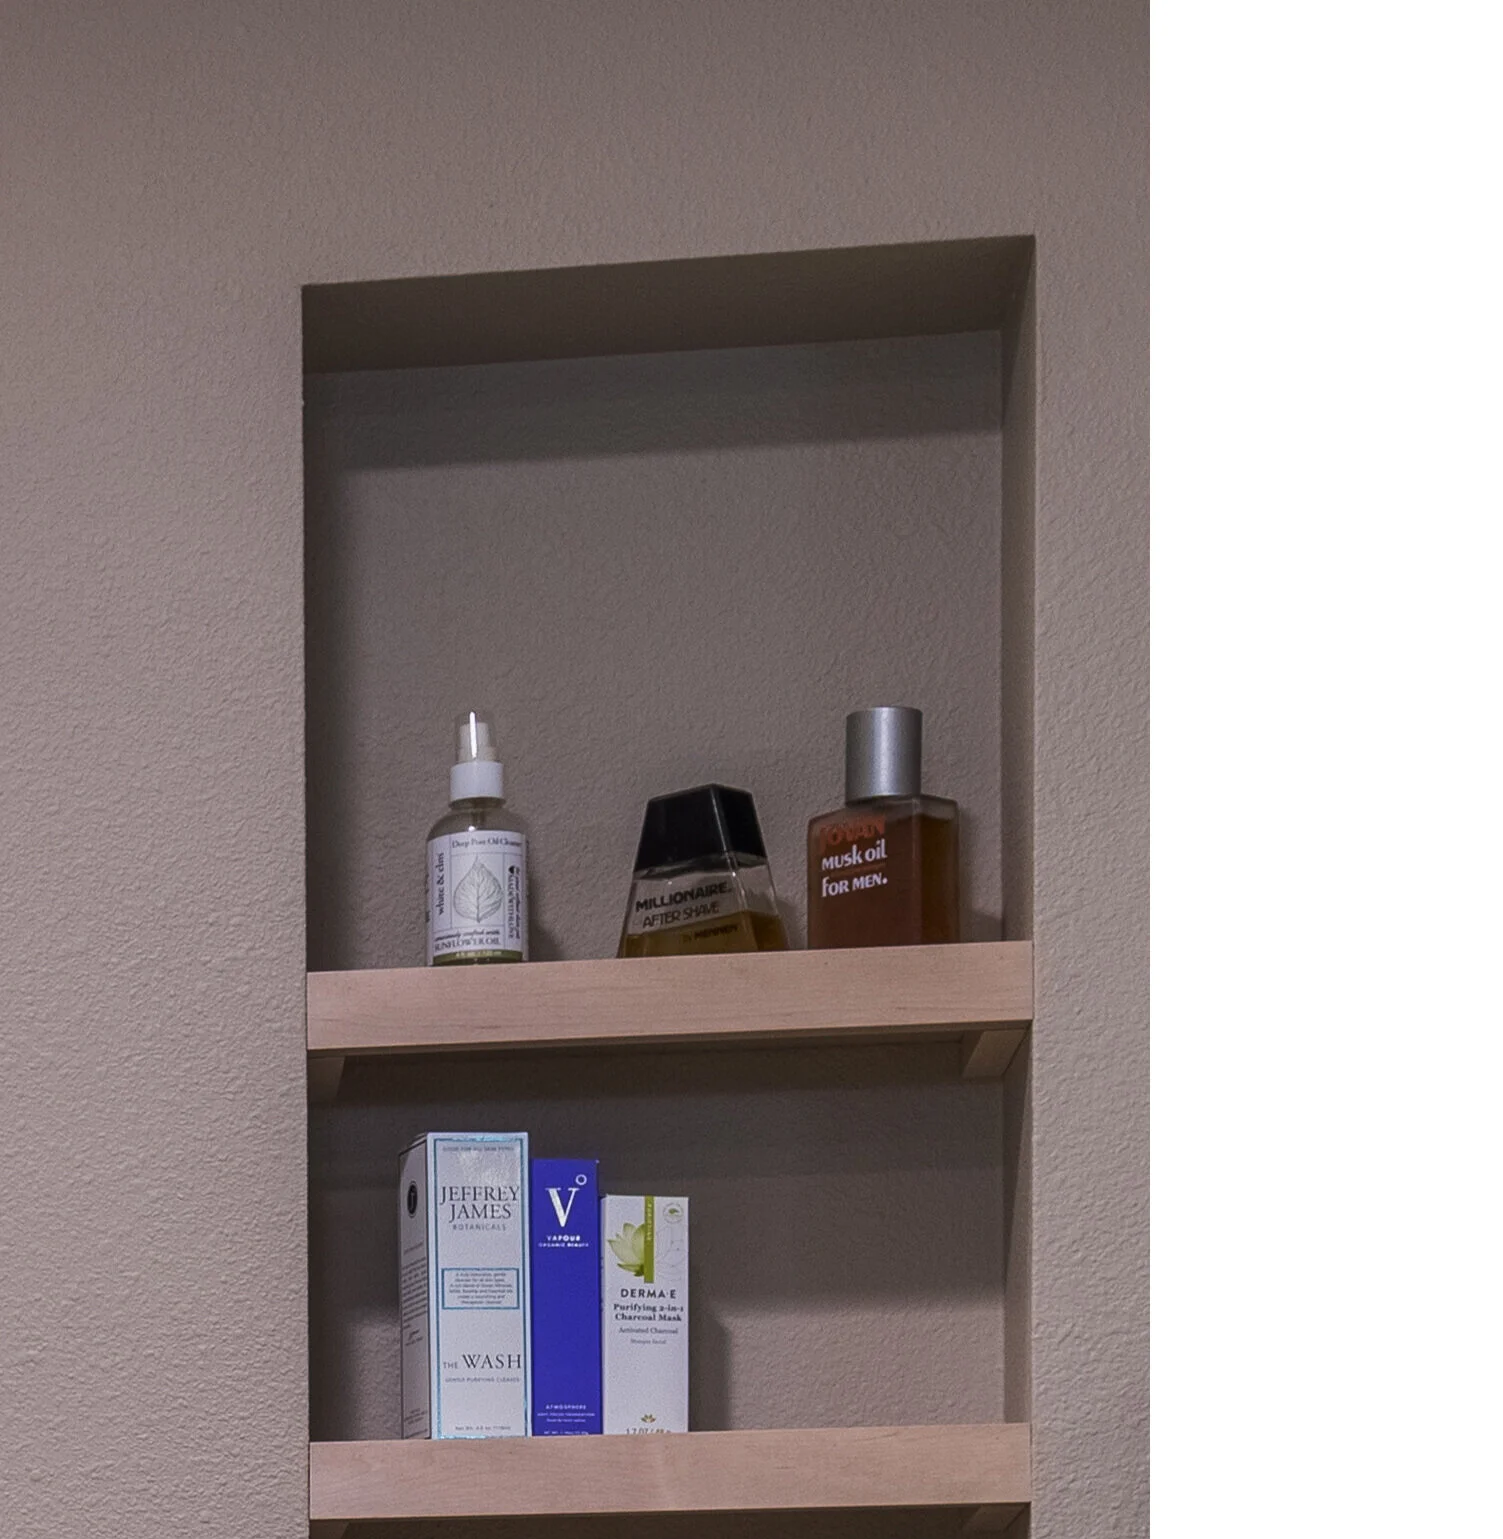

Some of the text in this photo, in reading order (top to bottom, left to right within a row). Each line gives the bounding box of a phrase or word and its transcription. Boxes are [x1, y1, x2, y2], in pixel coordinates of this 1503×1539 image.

[865, 838, 887, 862] oil
[643, 901, 720, 928] AFTER SHAVE
[440, 1186, 520, 1205] JEFFREY
[449, 1203, 512, 1223] JAMES
[453, 1223, 507, 1231] BOTANICALS
[613, 1303, 657, 1313] Purifying
[615, 1313, 656, 1321] Charcoal
[443, 1353, 521, 1369] THE WASH
